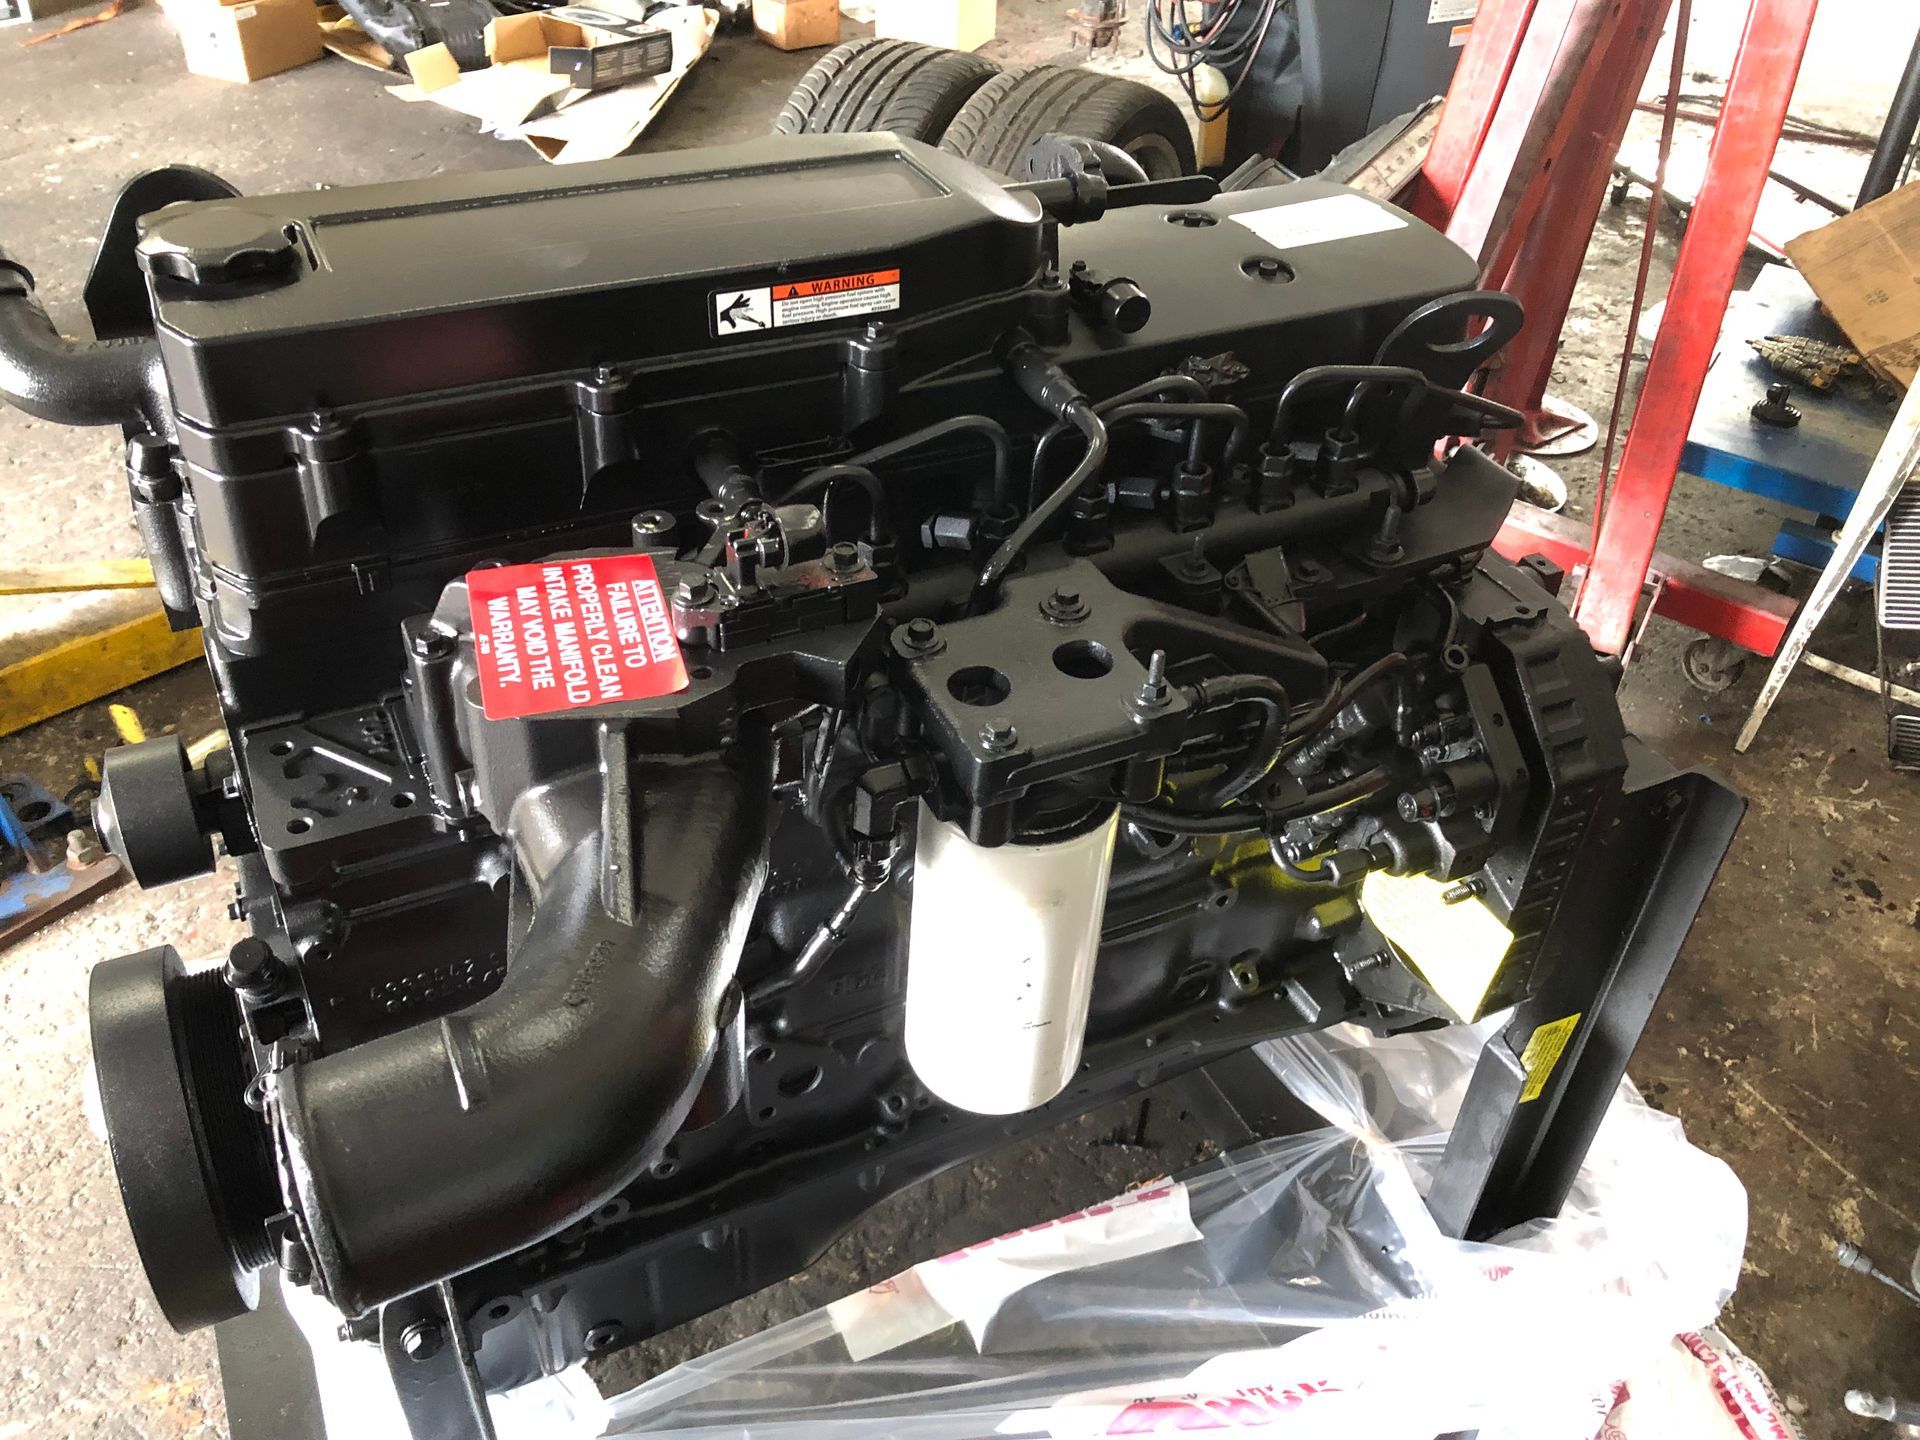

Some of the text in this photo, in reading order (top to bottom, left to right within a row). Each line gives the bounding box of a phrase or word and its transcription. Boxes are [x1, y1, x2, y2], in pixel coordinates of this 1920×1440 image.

[812, 274, 874, 294] WARNING
[487, 596, 522, 688] WARRANTY.
[516, 586, 556, 691] MAY VOID THE
[542, 566, 591, 704] INTAKE MANIFOLD
[571, 564, 624, 699] PROPERLY CLEAN
[606, 582, 648, 668] FAILURE TO
[634, 579, 678, 662] ATTENTION
